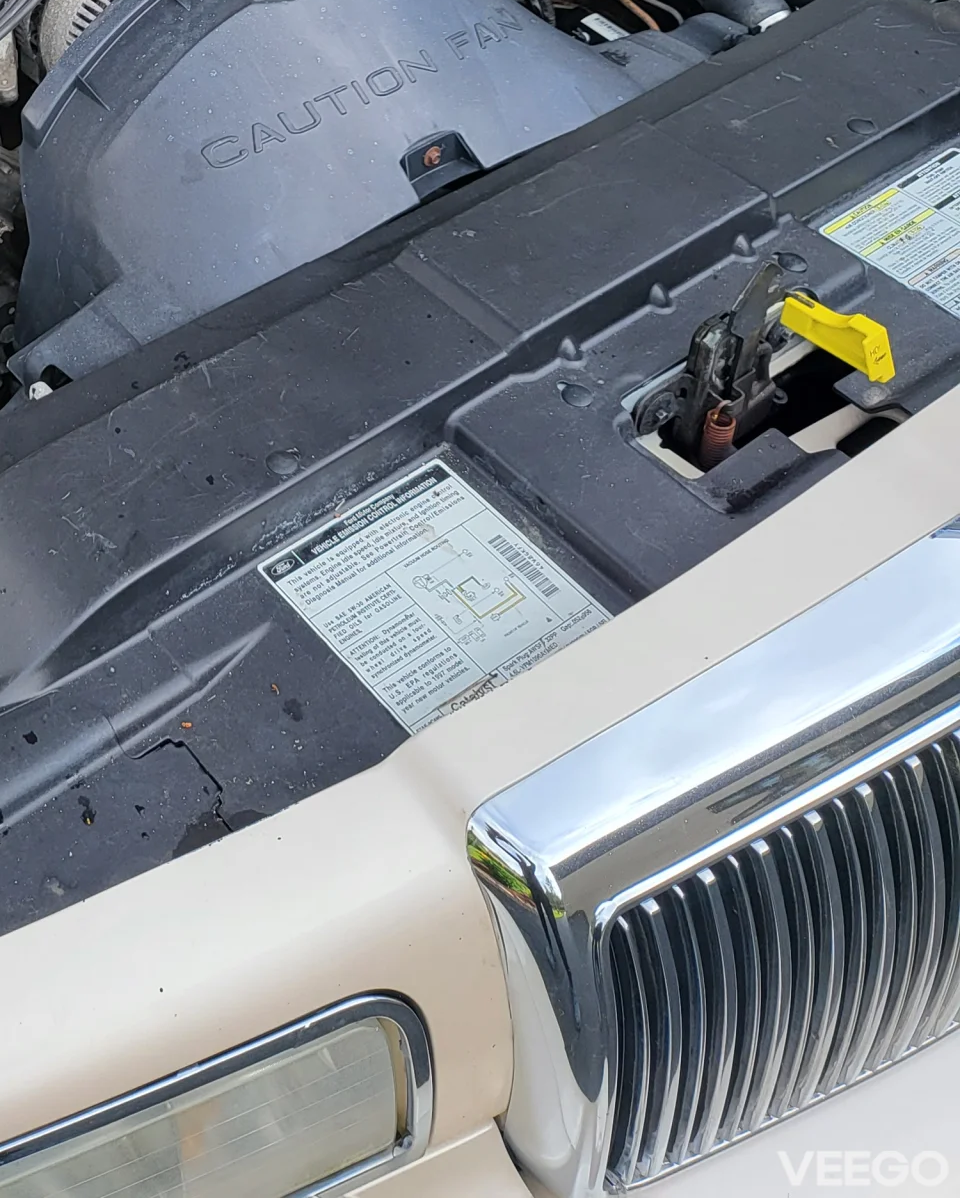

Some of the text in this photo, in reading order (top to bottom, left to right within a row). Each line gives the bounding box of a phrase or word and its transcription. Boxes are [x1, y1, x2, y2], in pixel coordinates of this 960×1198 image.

[200, 7, 524, 169] CAUTION FAN
[311, 477, 437, 555] VEHICLE EMISSION CONTROL INFORMATION
[355, 506, 372, 518] Motor
[370, 493, 395, 509] Company
[287, 575, 302, 585] This
[303, 560, 326, 576] vehicle
[334, 538, 365, 558] equipped
[364, 529, 378, 539] with
[378, 510, 409, 530] electronic
[410, 498, 431, 512] engine
[293, 489, 459, 592] systems. Engine idle speed, idle mixture, and ignition timing
[299, 495, 465, 598] are not adjustable. See Powertrain Control/Emissions
[305, 584, 336, 605] Diagnosis
[335, 571, 357, 586] Manual
[356, 565, 366, 573] for
[365, 548, 395, 567] additional
[323, 619, 334, 627] Use
[335, 611, 346, 620] SAE
[363, 583, 391, 601] AMERICAN
[328, 613, 357, 632] PETROLEUM
[356, 598, 381, 615] INSTITUTE
[333, 628, 347, 638] FIED
[348, 619, 362, 629] OILS
[373, 594, 402, 612] GASOLINE
[348, 634, 380, 655] ATTENTION:
[354, 648, 373, 661] testing
[378, 637, 389, 645] this
[389, 626, 407, 638] vehicle
[407, 617, 420, 627] must
[368, 641, 397, 660] conducted
[412, 622, 426, 632] four-
[389, 644, 407, 656] drive
[411, 628, 433, 642] speed
[370, 656, 405, 678] synchronized
[382, 682, 396, 692] This
[396, 668, 418, 683] vehicle
[416, 651, 445, 670] conforms
[388, 653, 459, 699] U.S. EPA regulations
[394, 685, 426, 706] applicable
[445, 658, 464, 671] model
[502, 659, 518, 671] Spark
[401, 665, 471, 713] year new motor vehicles.
